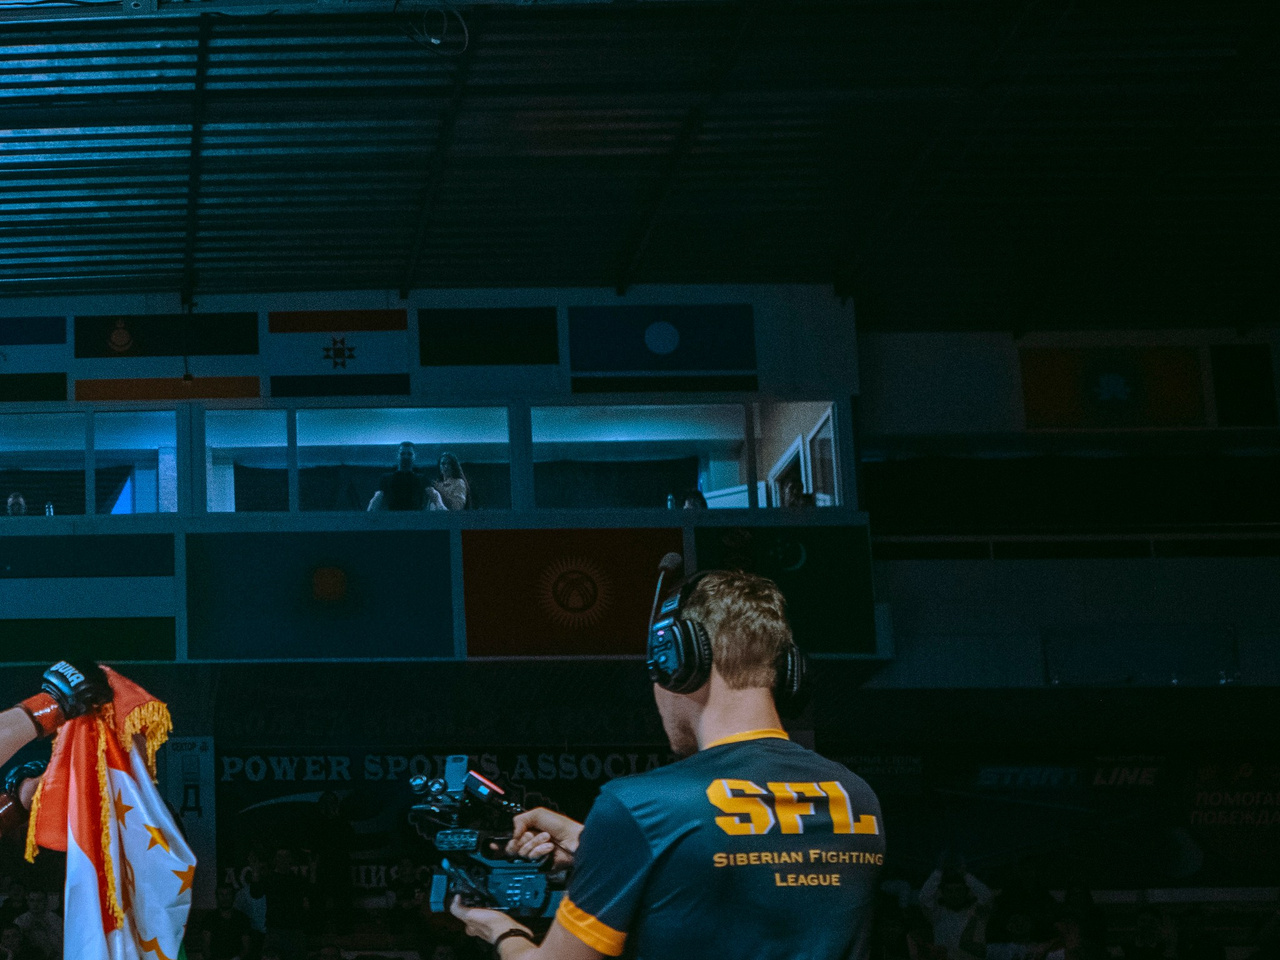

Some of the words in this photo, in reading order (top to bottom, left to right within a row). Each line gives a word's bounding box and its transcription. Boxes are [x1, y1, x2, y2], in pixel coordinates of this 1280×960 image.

[220, 755, 352, 782] POWER
[364, 753, 501, 781] SPOS
[512, 752, 676, 781] ASSOCIA
[1092, 766, 1159, 786] LINE
[705, 778, 879, 835] SFL
[713, 851, 803, 868] SIBERIAN
[809, 849, 884, 866] FIGHTING
[775, 872, 841, 887] LEAGUE
